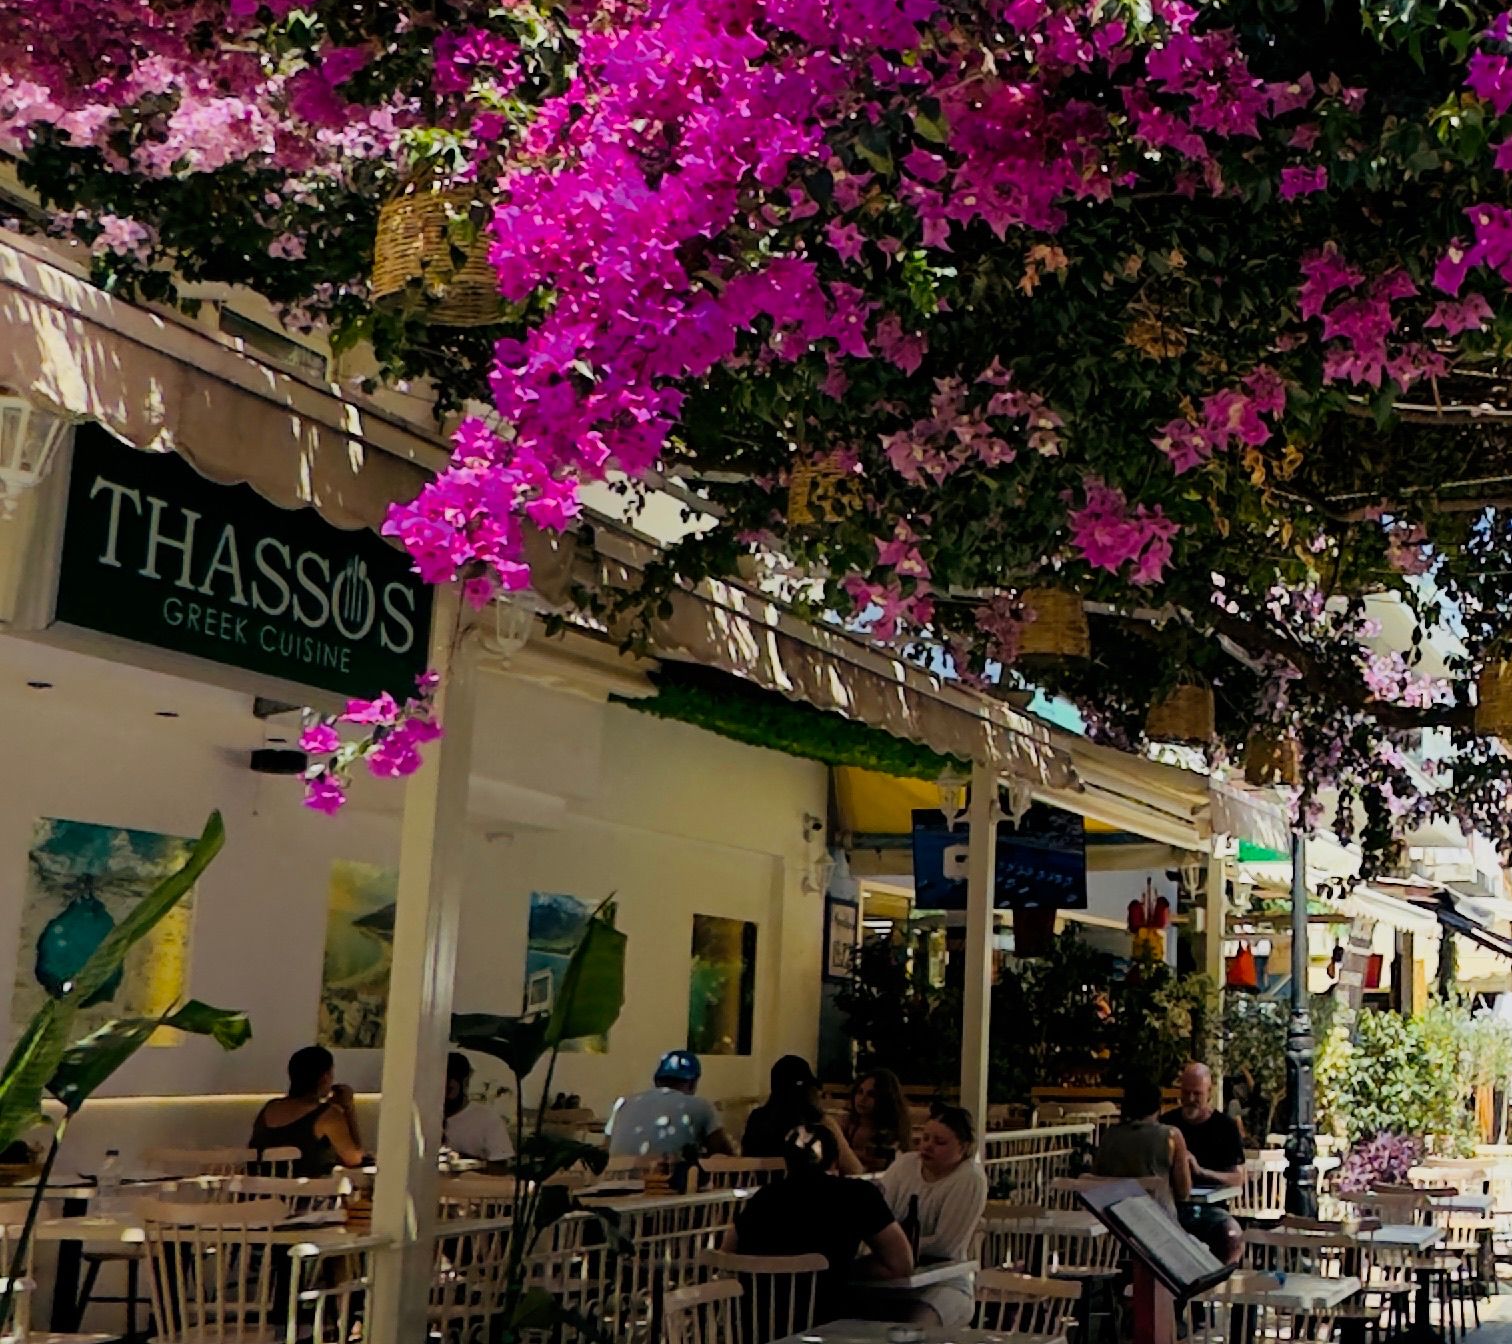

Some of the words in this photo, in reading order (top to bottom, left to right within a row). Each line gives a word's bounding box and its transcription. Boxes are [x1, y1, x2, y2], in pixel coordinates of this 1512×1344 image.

[91, 476, 415, 653] THASSOS
[163, 598, 248, 644] GREEK
[260, 626, 351, 674] CUISINE
